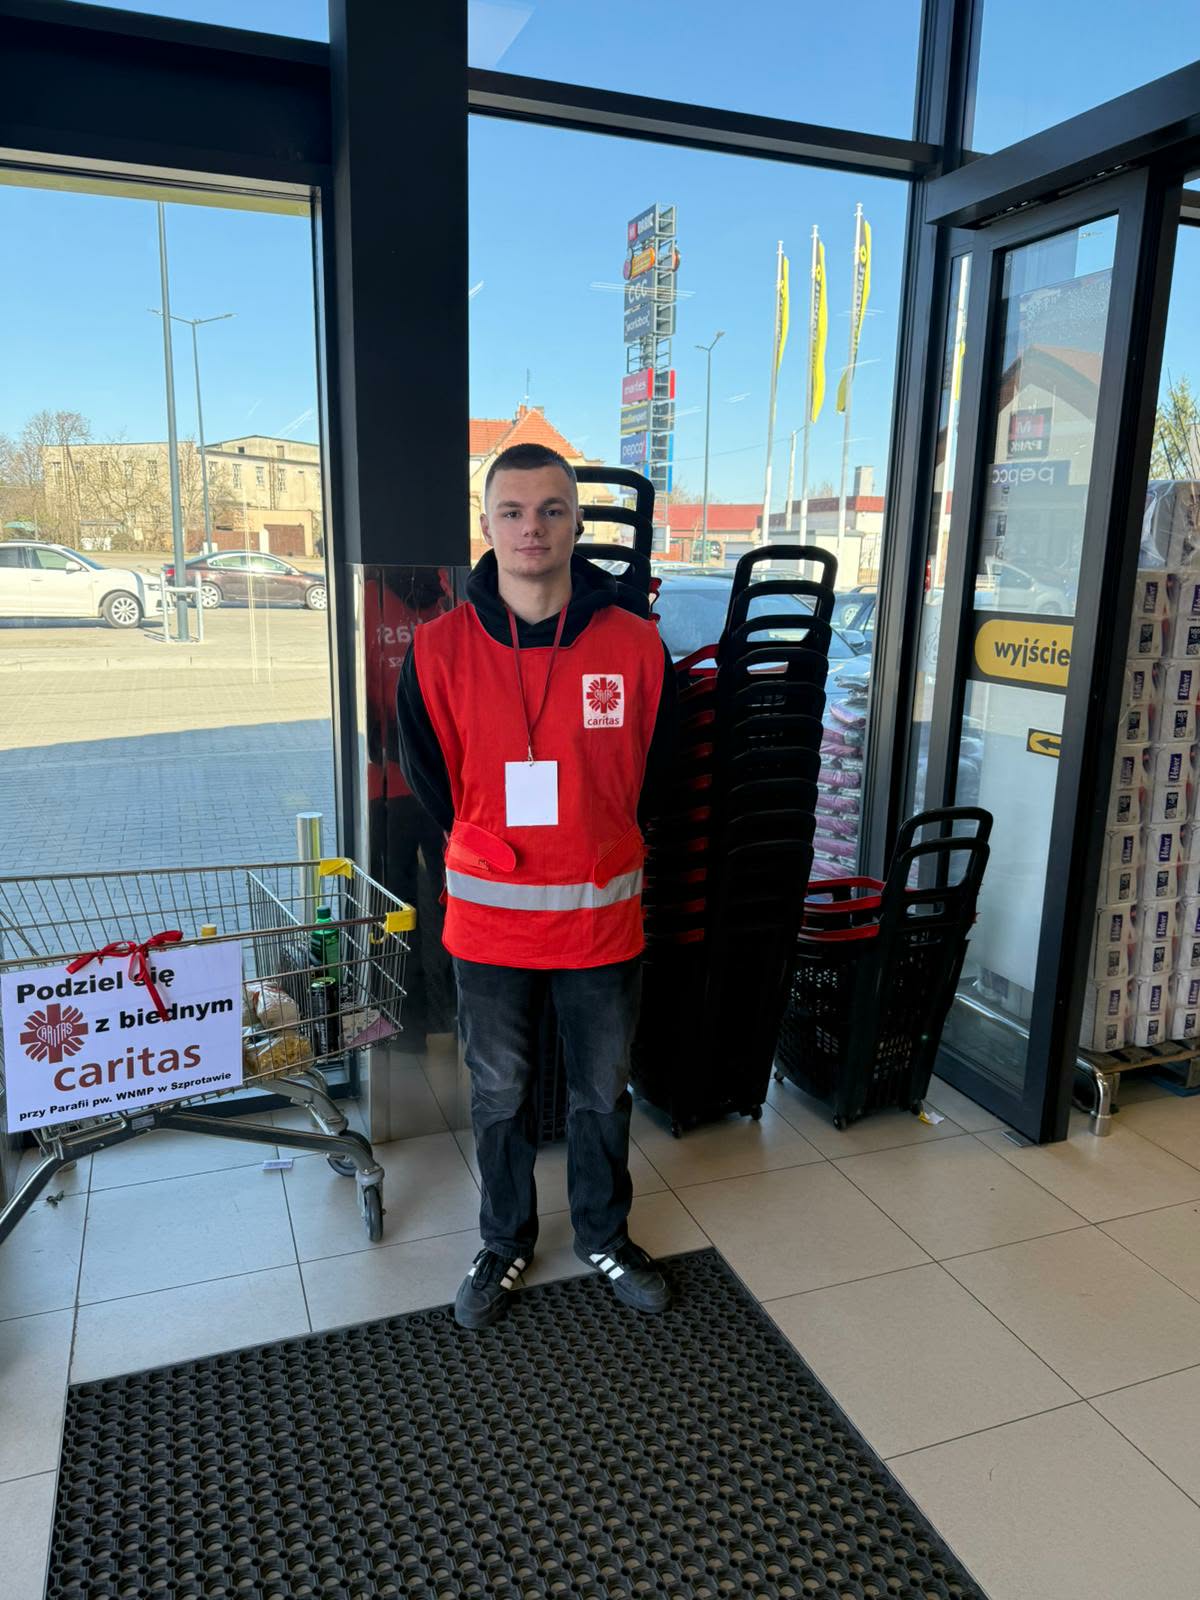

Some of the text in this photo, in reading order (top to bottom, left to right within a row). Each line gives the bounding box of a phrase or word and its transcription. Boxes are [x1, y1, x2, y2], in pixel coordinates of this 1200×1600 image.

[628, 279, 648, 304] CCC
[622, 441, 645, 457] pepco
[994, 638, 1070, 667] wyjście
[1179, 673, 1191, 697] Velvet
[587, 716, 620, 726] caritas
[1169, 756, 1181, 780] Velvet
[1160, 836, 1171, 859] Velvet
[17, 971, 123, 1004] Podziel
[95, 1019, 109, 1033] z
[53, 1044, 202, 1092] caritas
[19, 1072, 232, 1122] przy Parafii pw. WNMP w Szprotawie
